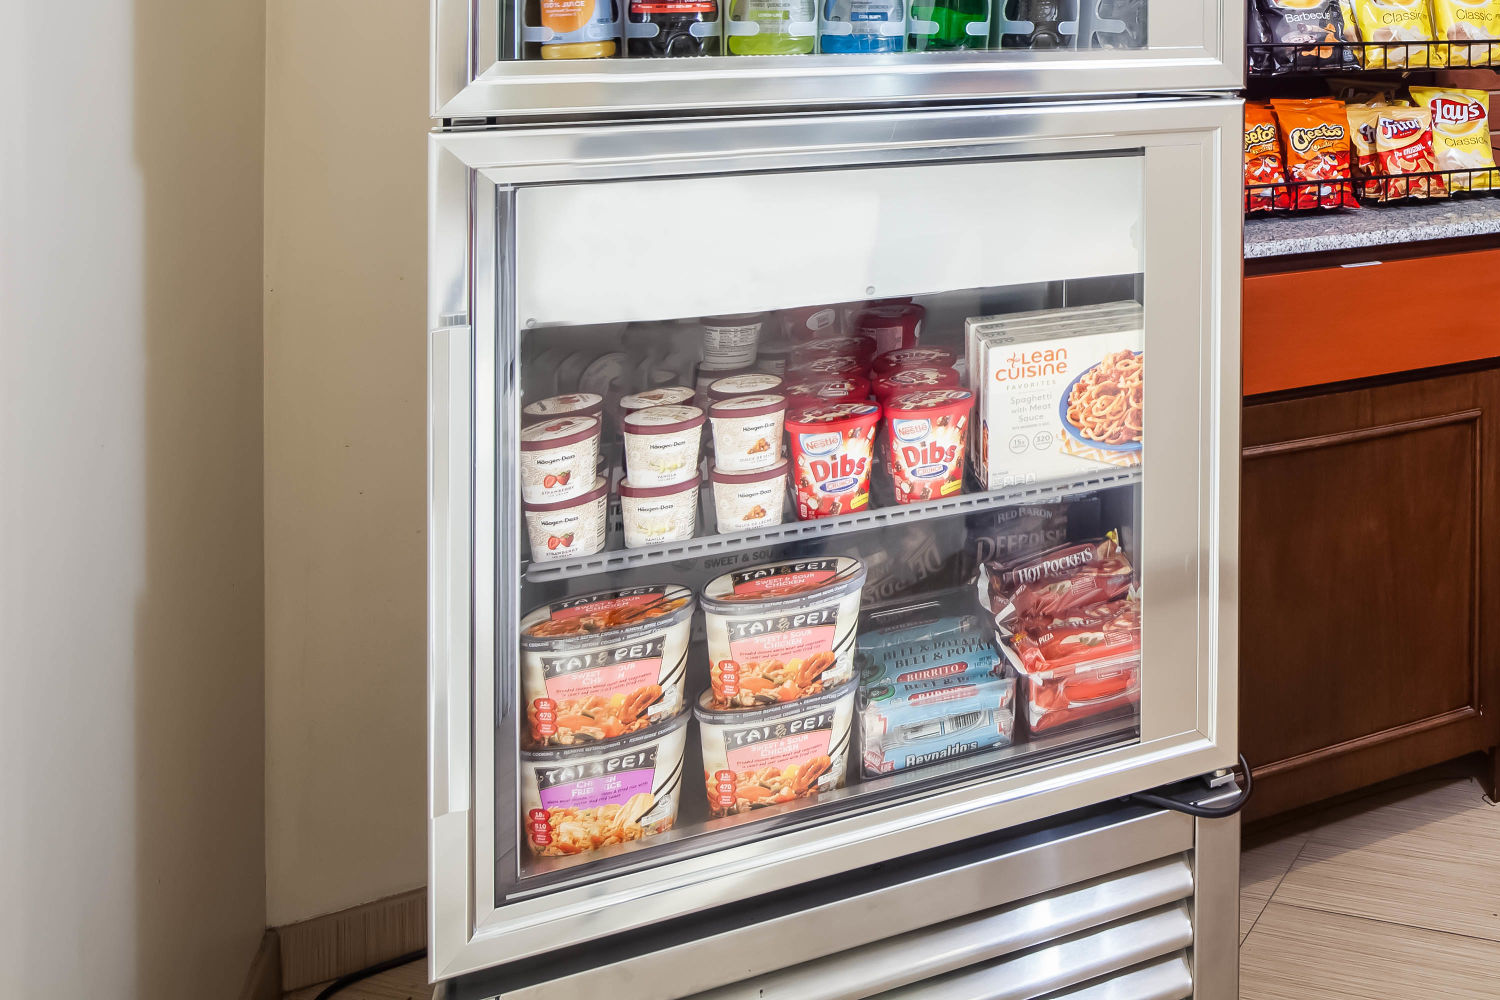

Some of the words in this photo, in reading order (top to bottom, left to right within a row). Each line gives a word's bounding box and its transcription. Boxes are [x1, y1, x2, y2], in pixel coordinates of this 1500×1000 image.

[561, 0, 585, 8] JUICE
[1455, 8, 1493, 21] Classic
[1284, 11, 1331, 24] Barbecue
[1433, 98, 1480, 124] Lay's
[1291, 124, 1344, 151] Cheetos
[1444, 135, 1485, 148] Classic
[1021, 348, 1068, 365] Lean
[1006, 380, 1057, 391] FAVORITES
[1010, 393, 1053, 405] Spaghetti
[1011, 406, 1027, 414] with
[1029, 402, 1052, 412] Meat
[1018, 414, 1044, 423] Sauce
[901, 442, 958, 468] Dibs
[809, 456, 867, 483] Dibs
[742, 569, 774, 582] TAI
[795, 561, 827, 573] PEI
[1018, 560, 1041, 584] HOT
[1043, 547, 1093, 577] POCKETS
[737, 619, 773, 635] TAI
[793, 610, 829, 628] PEI
[552, 655, 591, 673] TAI
[615, 643, 652, 660] PEI
[906, 664, 959, 682] BURRITO
[734, 729, 769, 746] TAI
[790, 716, 824, 733] PEI
[905, 740, 978, 768] Reynaldo's
[546, 767, 588, 784] TAI
[607, 752, 646, 771] PEI
